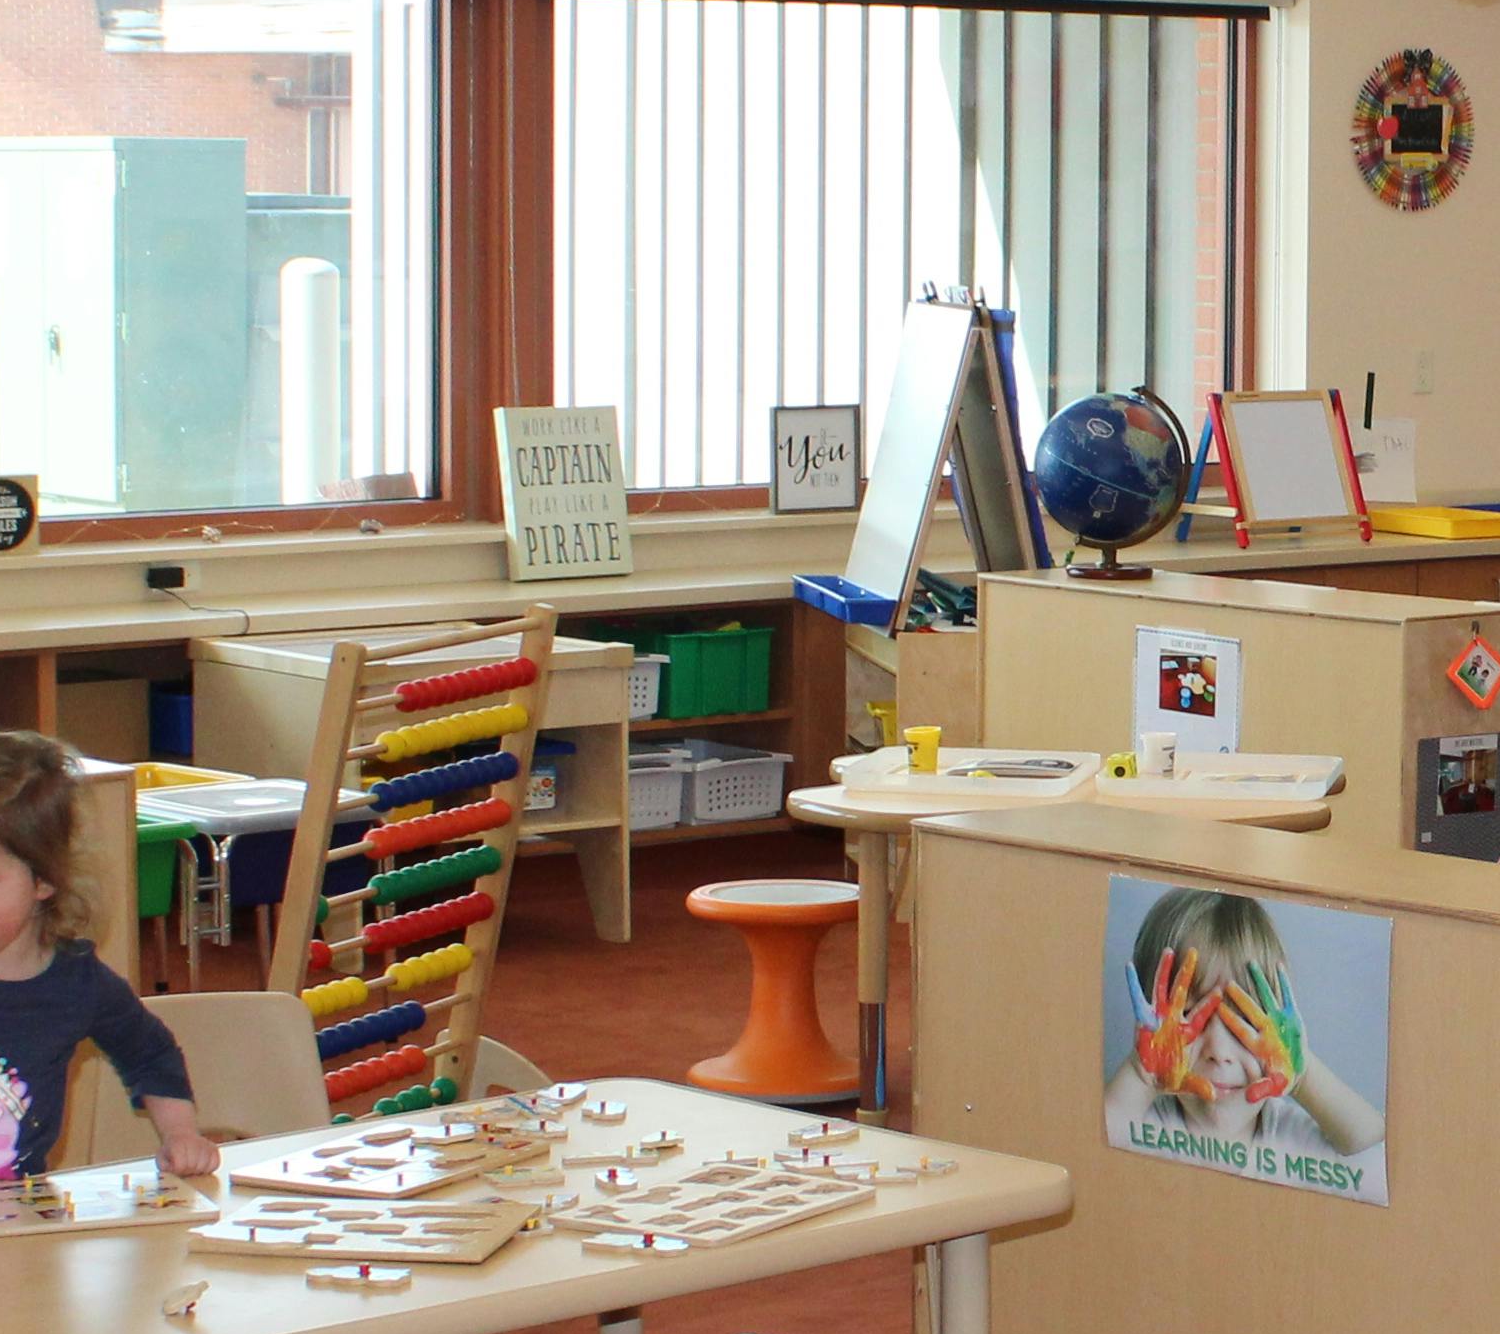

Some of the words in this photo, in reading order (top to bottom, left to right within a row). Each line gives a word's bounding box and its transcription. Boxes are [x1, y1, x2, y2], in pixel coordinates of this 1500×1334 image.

[516, 443, 612, 487] CAPTAIN
[779, 435, 851, 484] You
[525, 522, 620, 566] PIRATE
[1129, 1120, 1248, 1169] LEARNING
[1256, 1147, 1277, 1175] IS
[1285, 1153, 1363, 1192] MESSY
